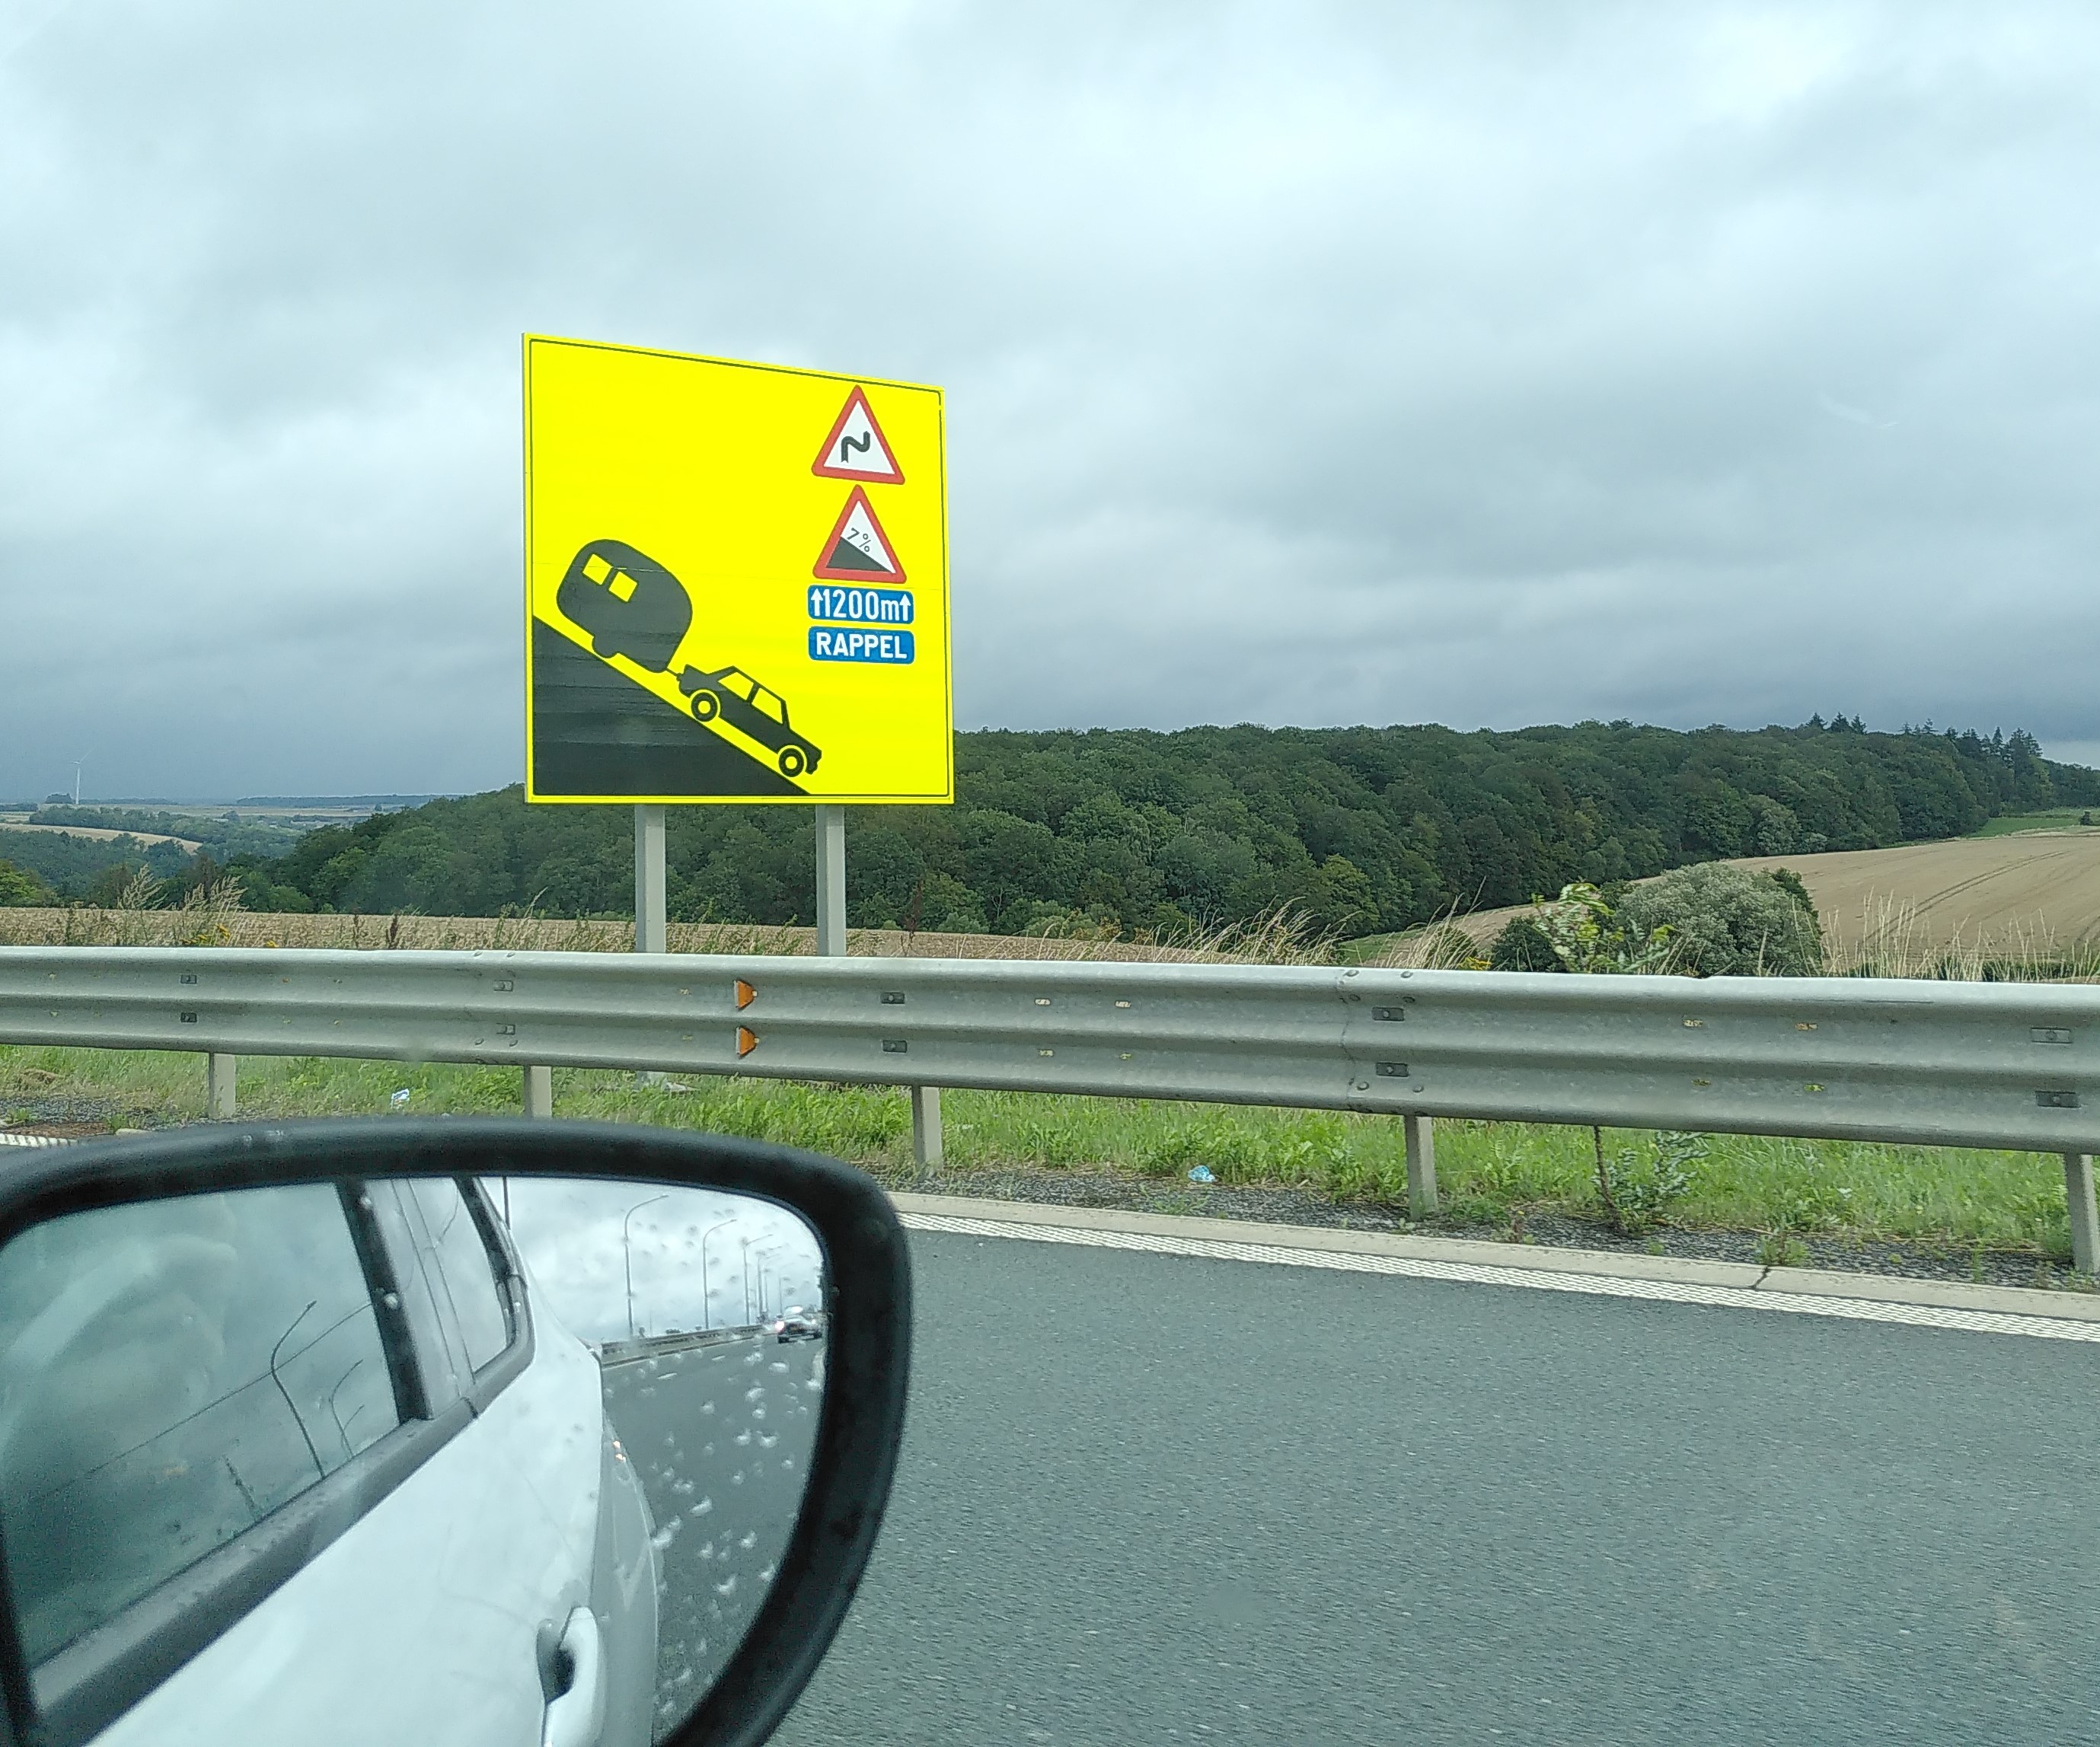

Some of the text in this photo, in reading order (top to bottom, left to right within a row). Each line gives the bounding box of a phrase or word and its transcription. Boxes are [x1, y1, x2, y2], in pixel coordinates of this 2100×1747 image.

[847, 528, 871, 552] 7%
[822, 588, 899, 620] 1200m
[816, 632, 907, 658] RAPPEL
